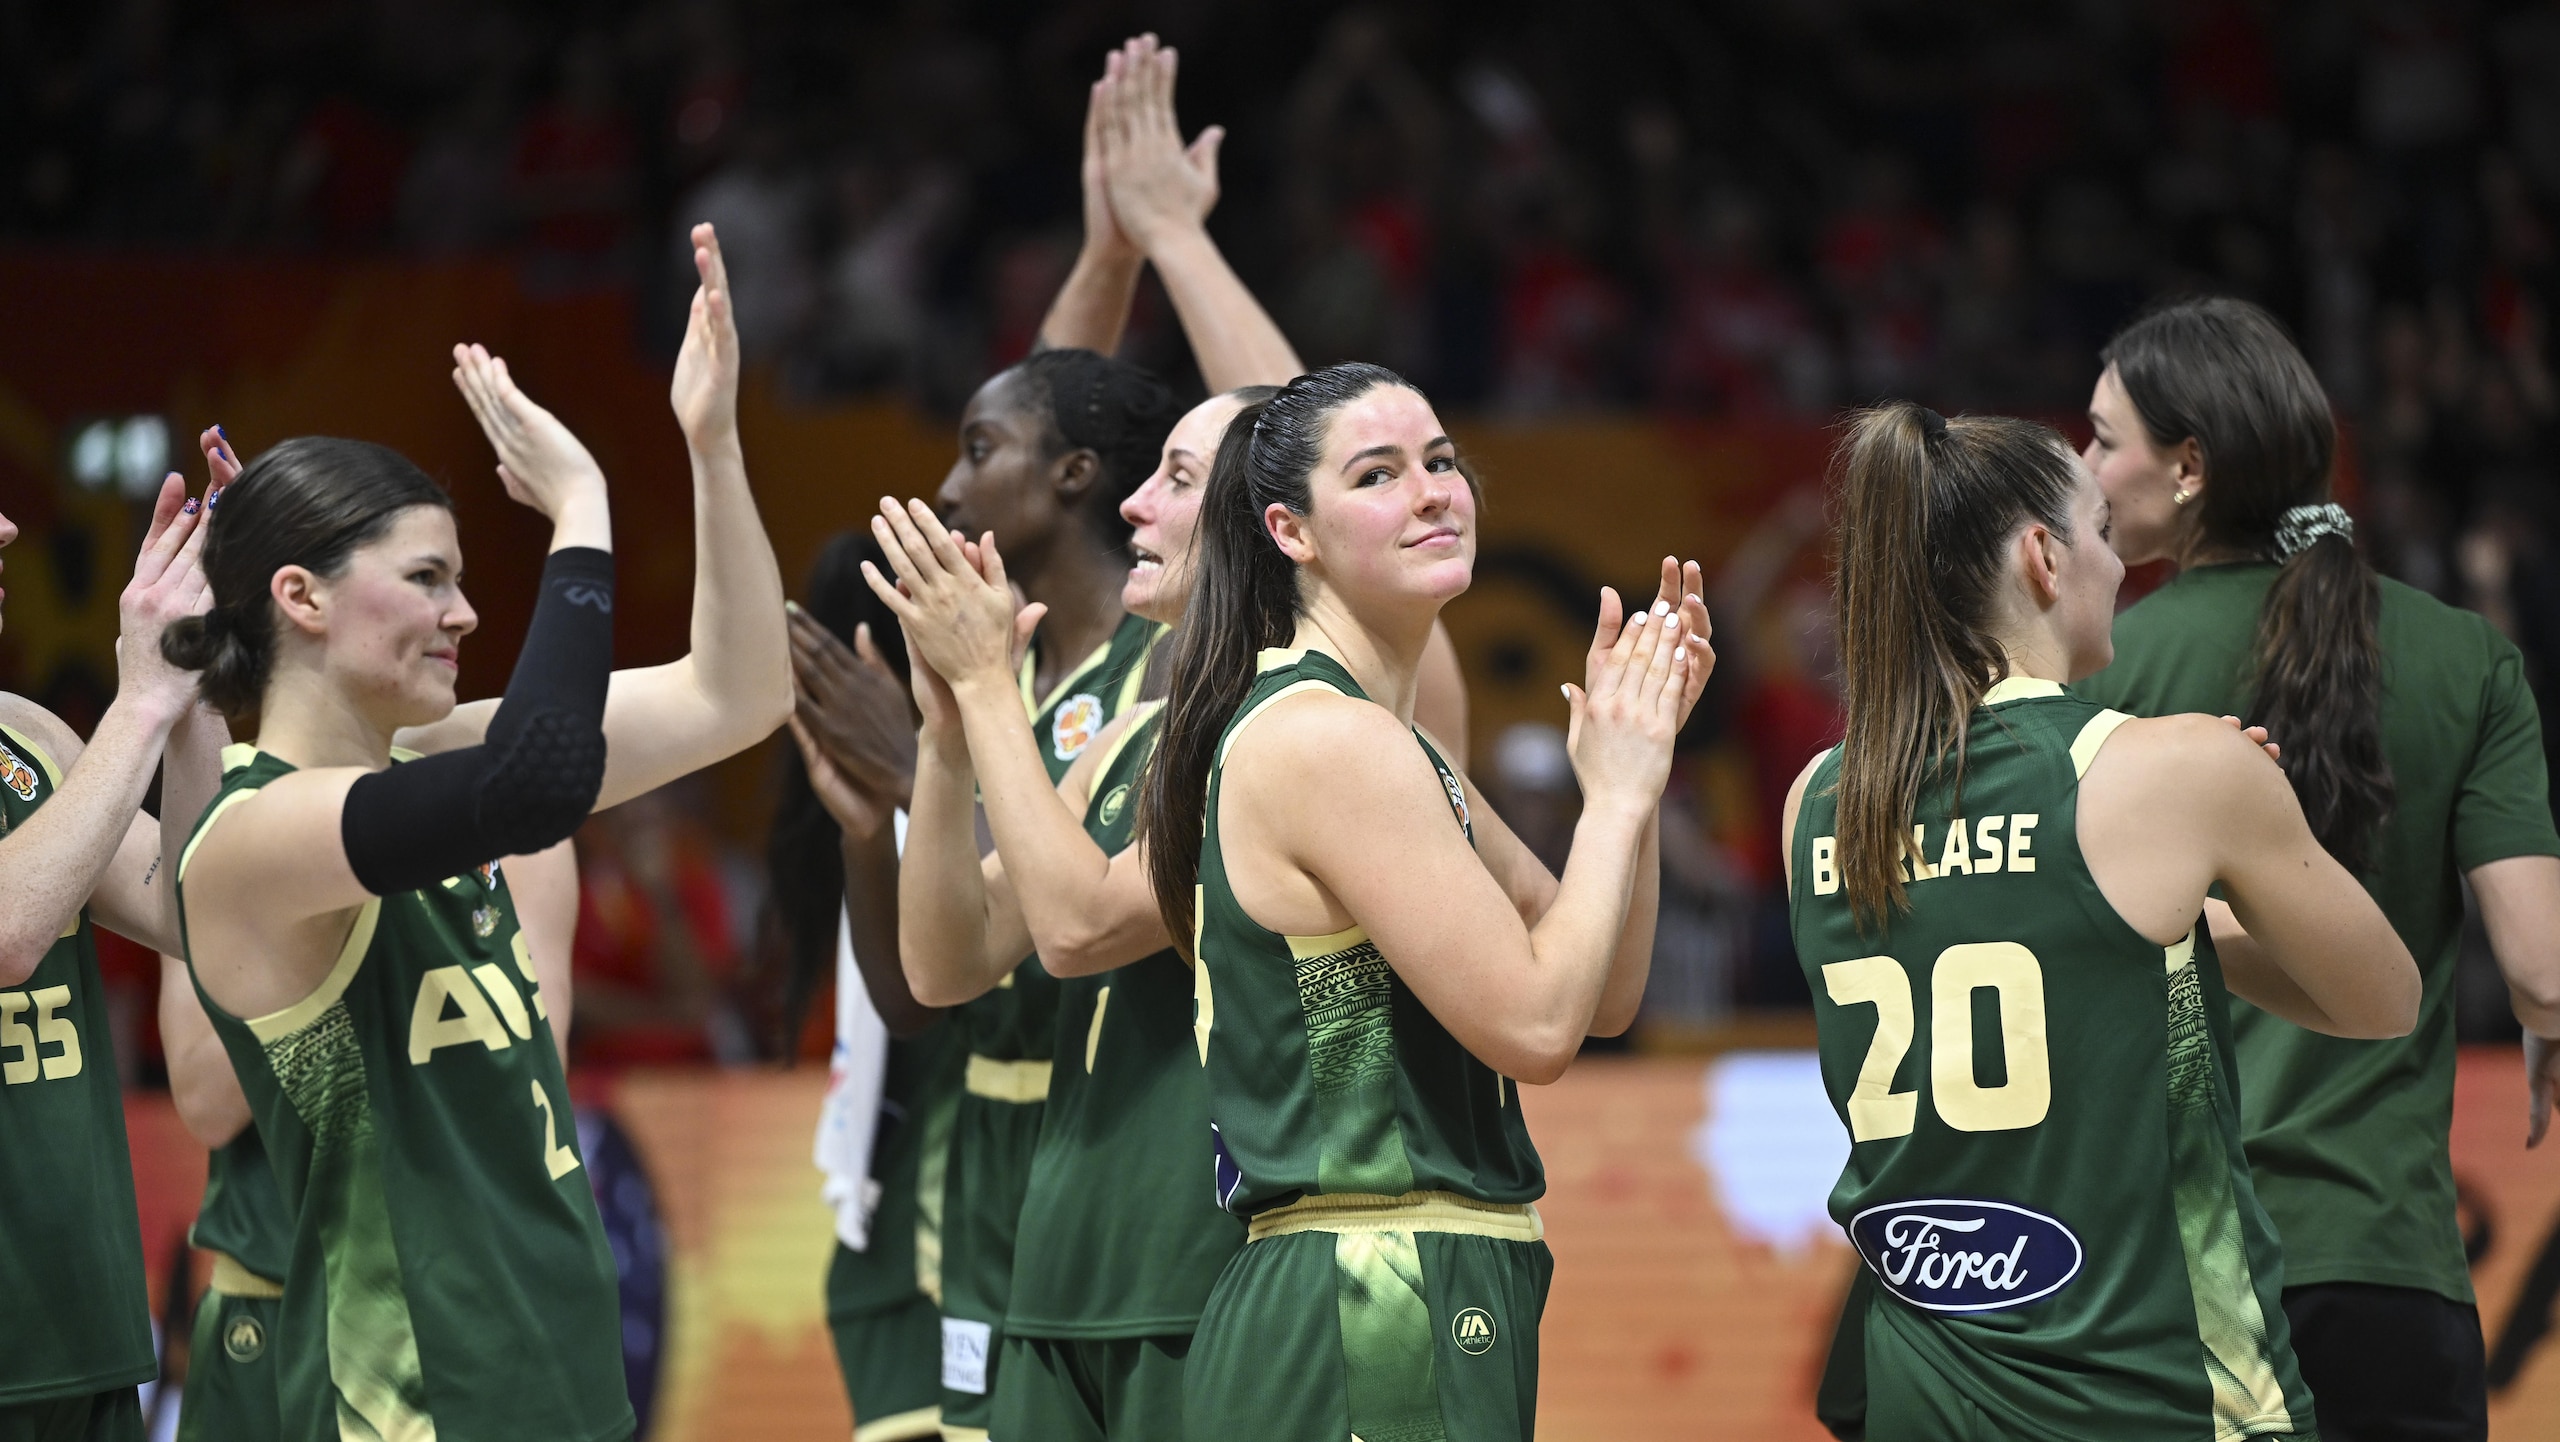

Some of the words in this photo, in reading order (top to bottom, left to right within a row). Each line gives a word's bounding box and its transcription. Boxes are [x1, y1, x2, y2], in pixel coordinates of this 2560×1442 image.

[1813, 814, 2039, 896] BLASE
[0, 984, 82, 1085] 55
[1821, 941, 2051, 1143] 20
[1880, 1214, 2028, 1291] Ford
